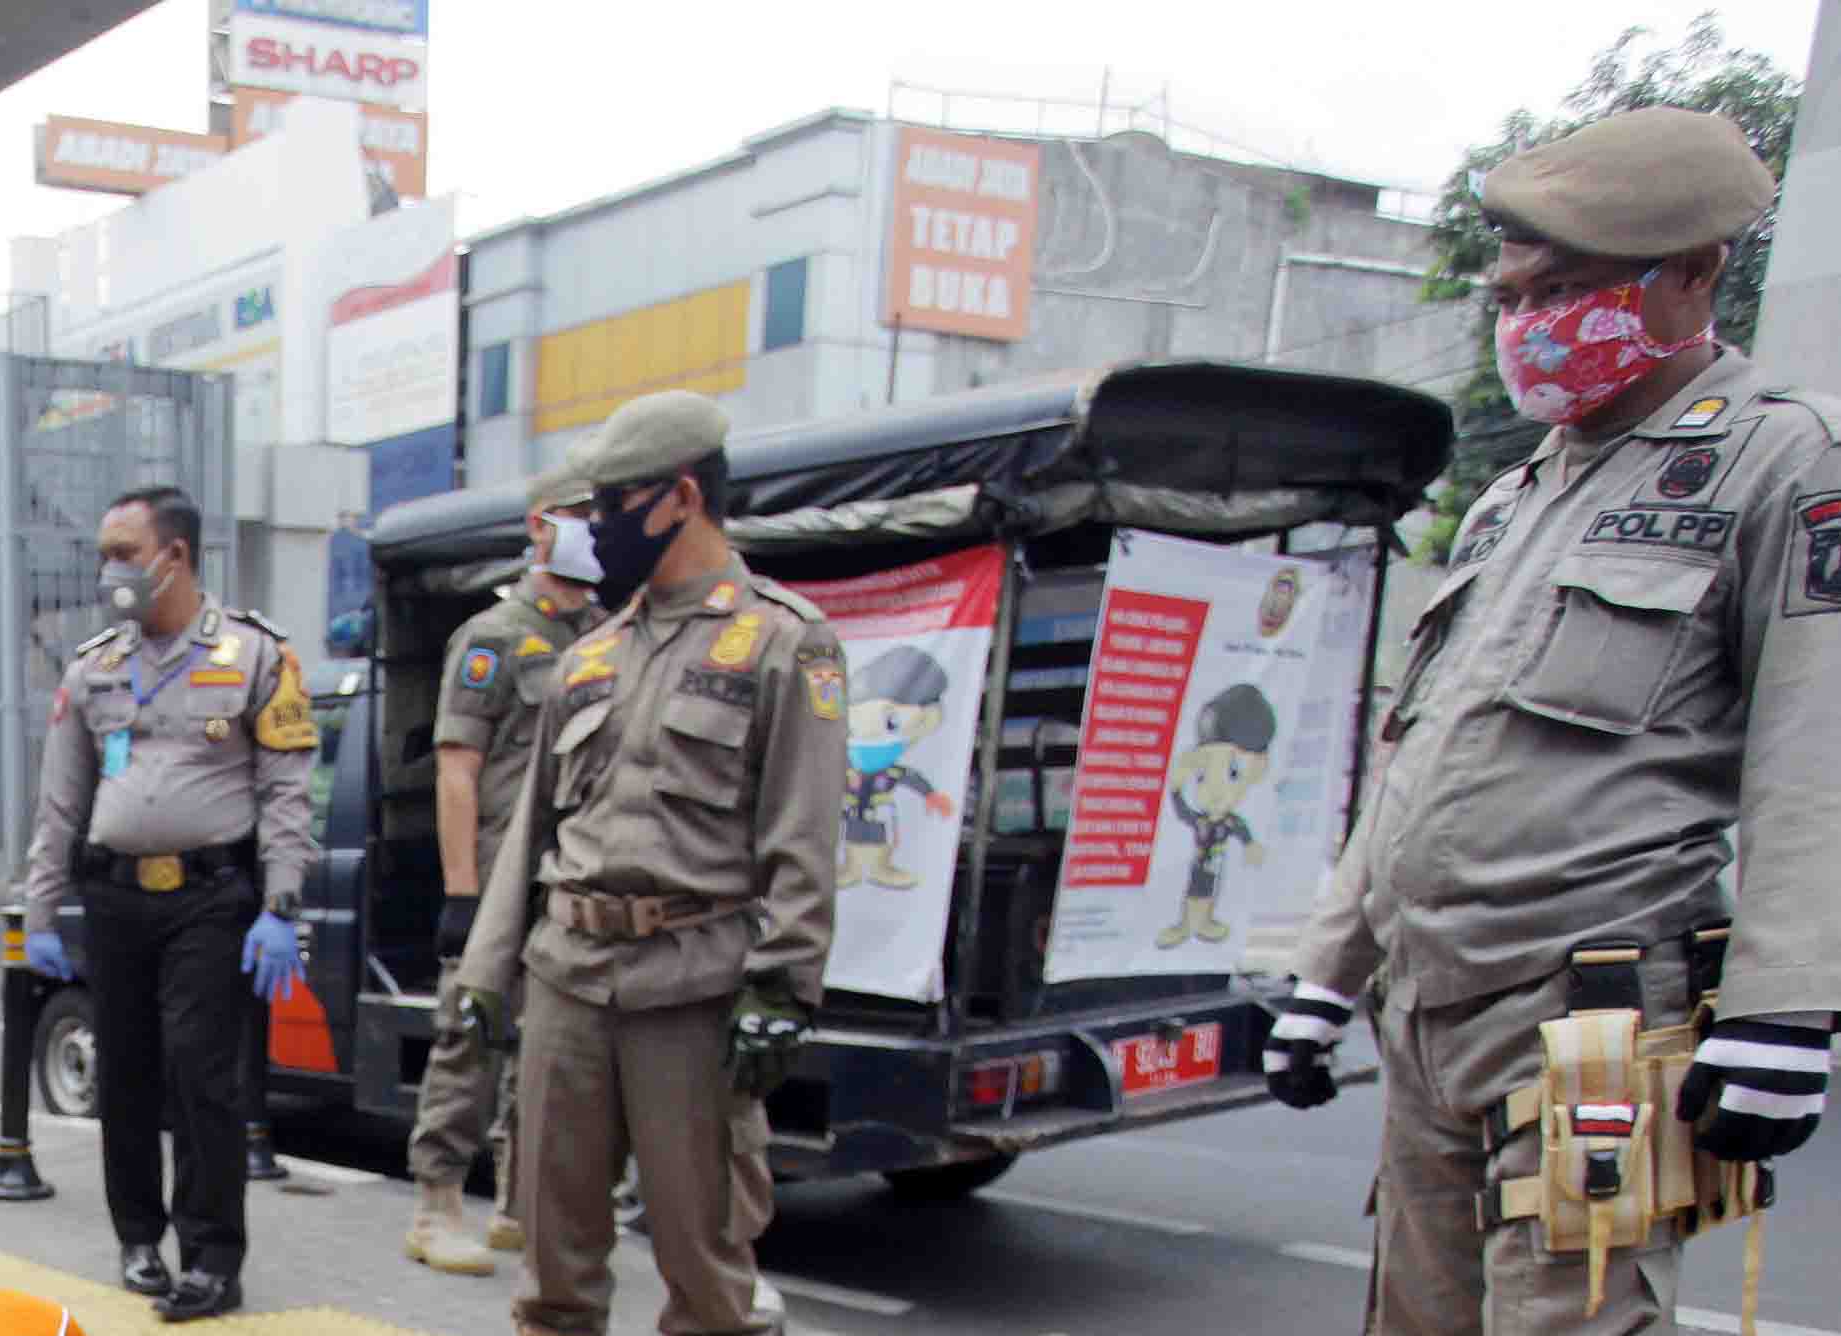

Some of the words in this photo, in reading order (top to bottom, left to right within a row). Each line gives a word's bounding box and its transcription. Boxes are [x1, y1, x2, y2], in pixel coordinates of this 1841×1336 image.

[247, 38, 418, 87] SHARP
[909, 207, 1021, 258] TETAP
[910, 266, 1012, 318] BUKA
[1593, 513, 1663, 538] POL
[1670, 515, 1726, 542] PP
